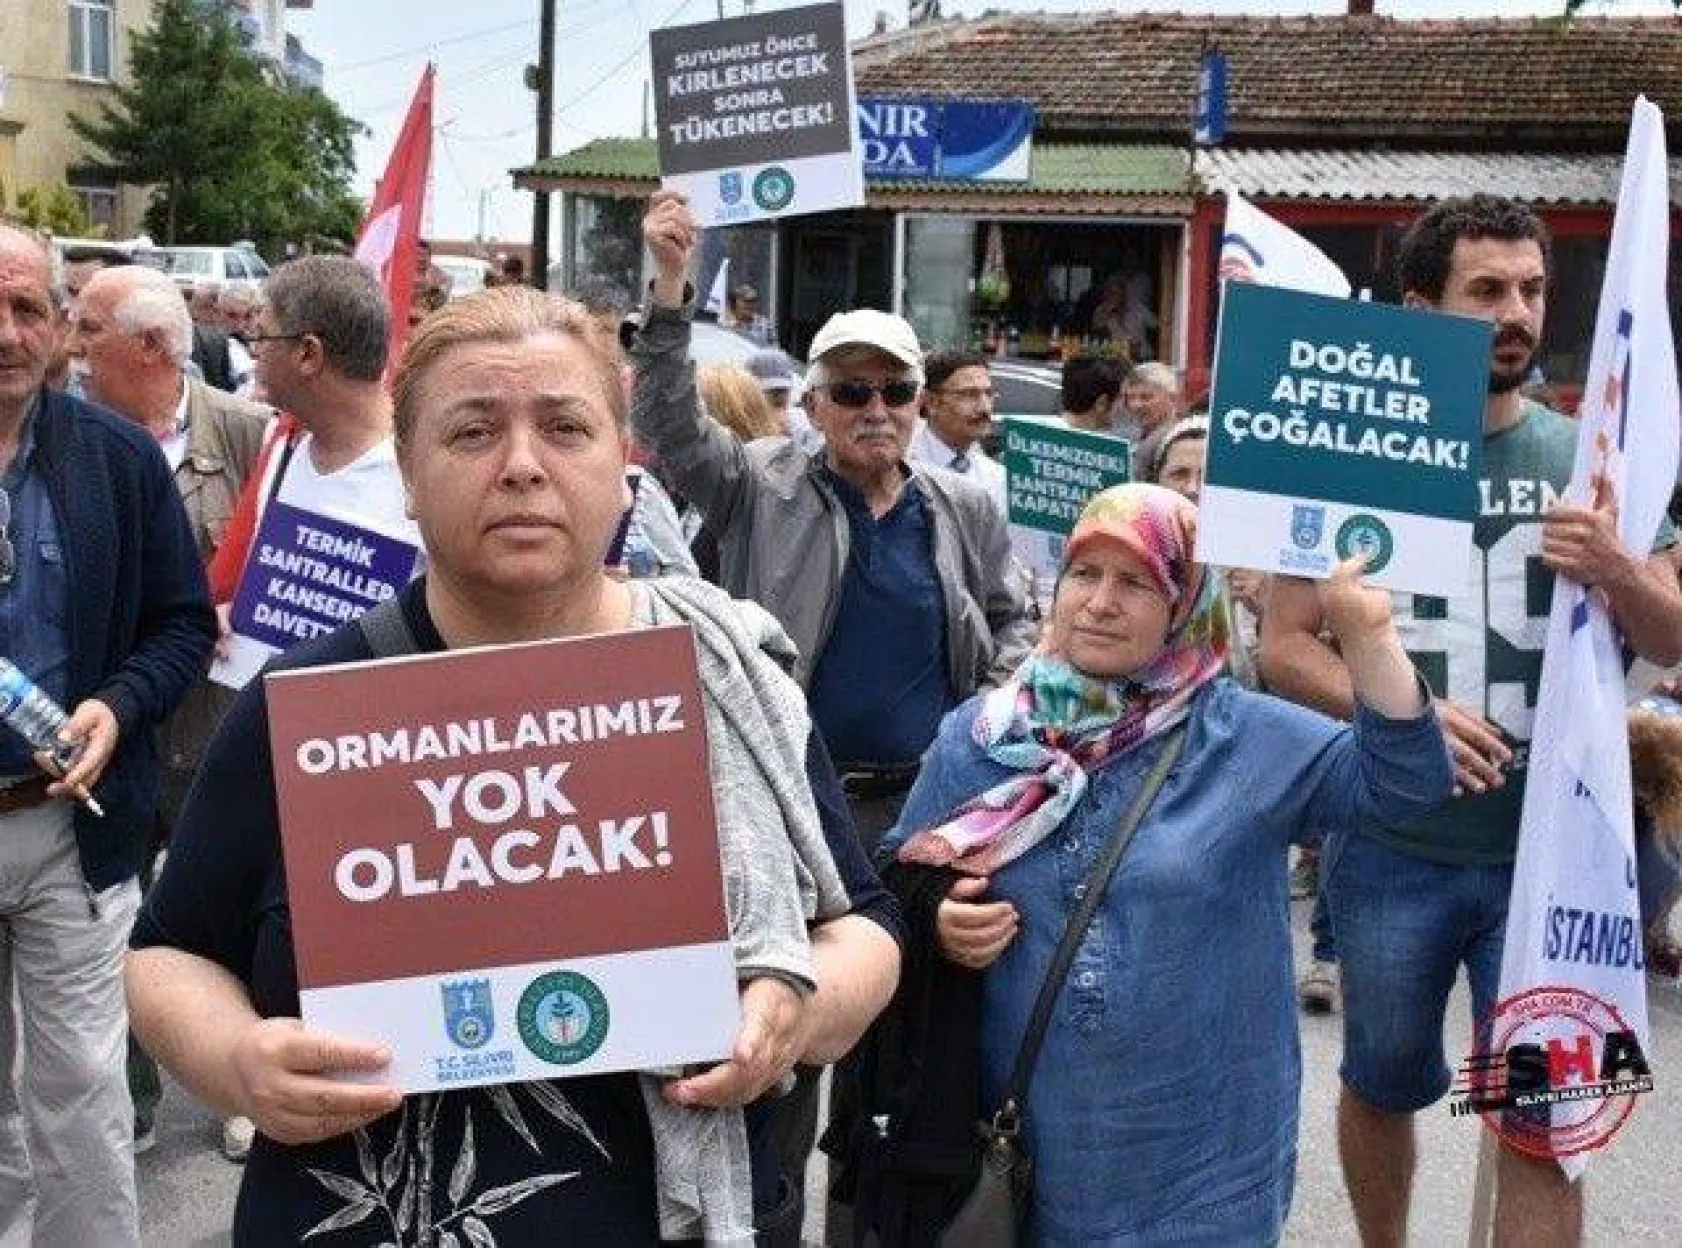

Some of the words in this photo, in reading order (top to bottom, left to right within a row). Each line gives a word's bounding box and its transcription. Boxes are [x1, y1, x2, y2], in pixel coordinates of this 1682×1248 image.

[765, 33, 818, 53] ÖNCE
[714, 87, 784, 111] SONRA
[670, 102, 834, 145] TÜKENECEK!
[1289, 339, 1421, 387] DOĞAL
[1271, 375, 1431, 424] AFETLER
[1223, 408, 1471, 471] ÇOĞALACAK!
[296, 524, 377, 568] TERMİK
[296, 695, 684, 775] ORMANLARIMIZ
[415, 761, 577, 830] YOK
[335, 811, 673, 903] OLACAK!
